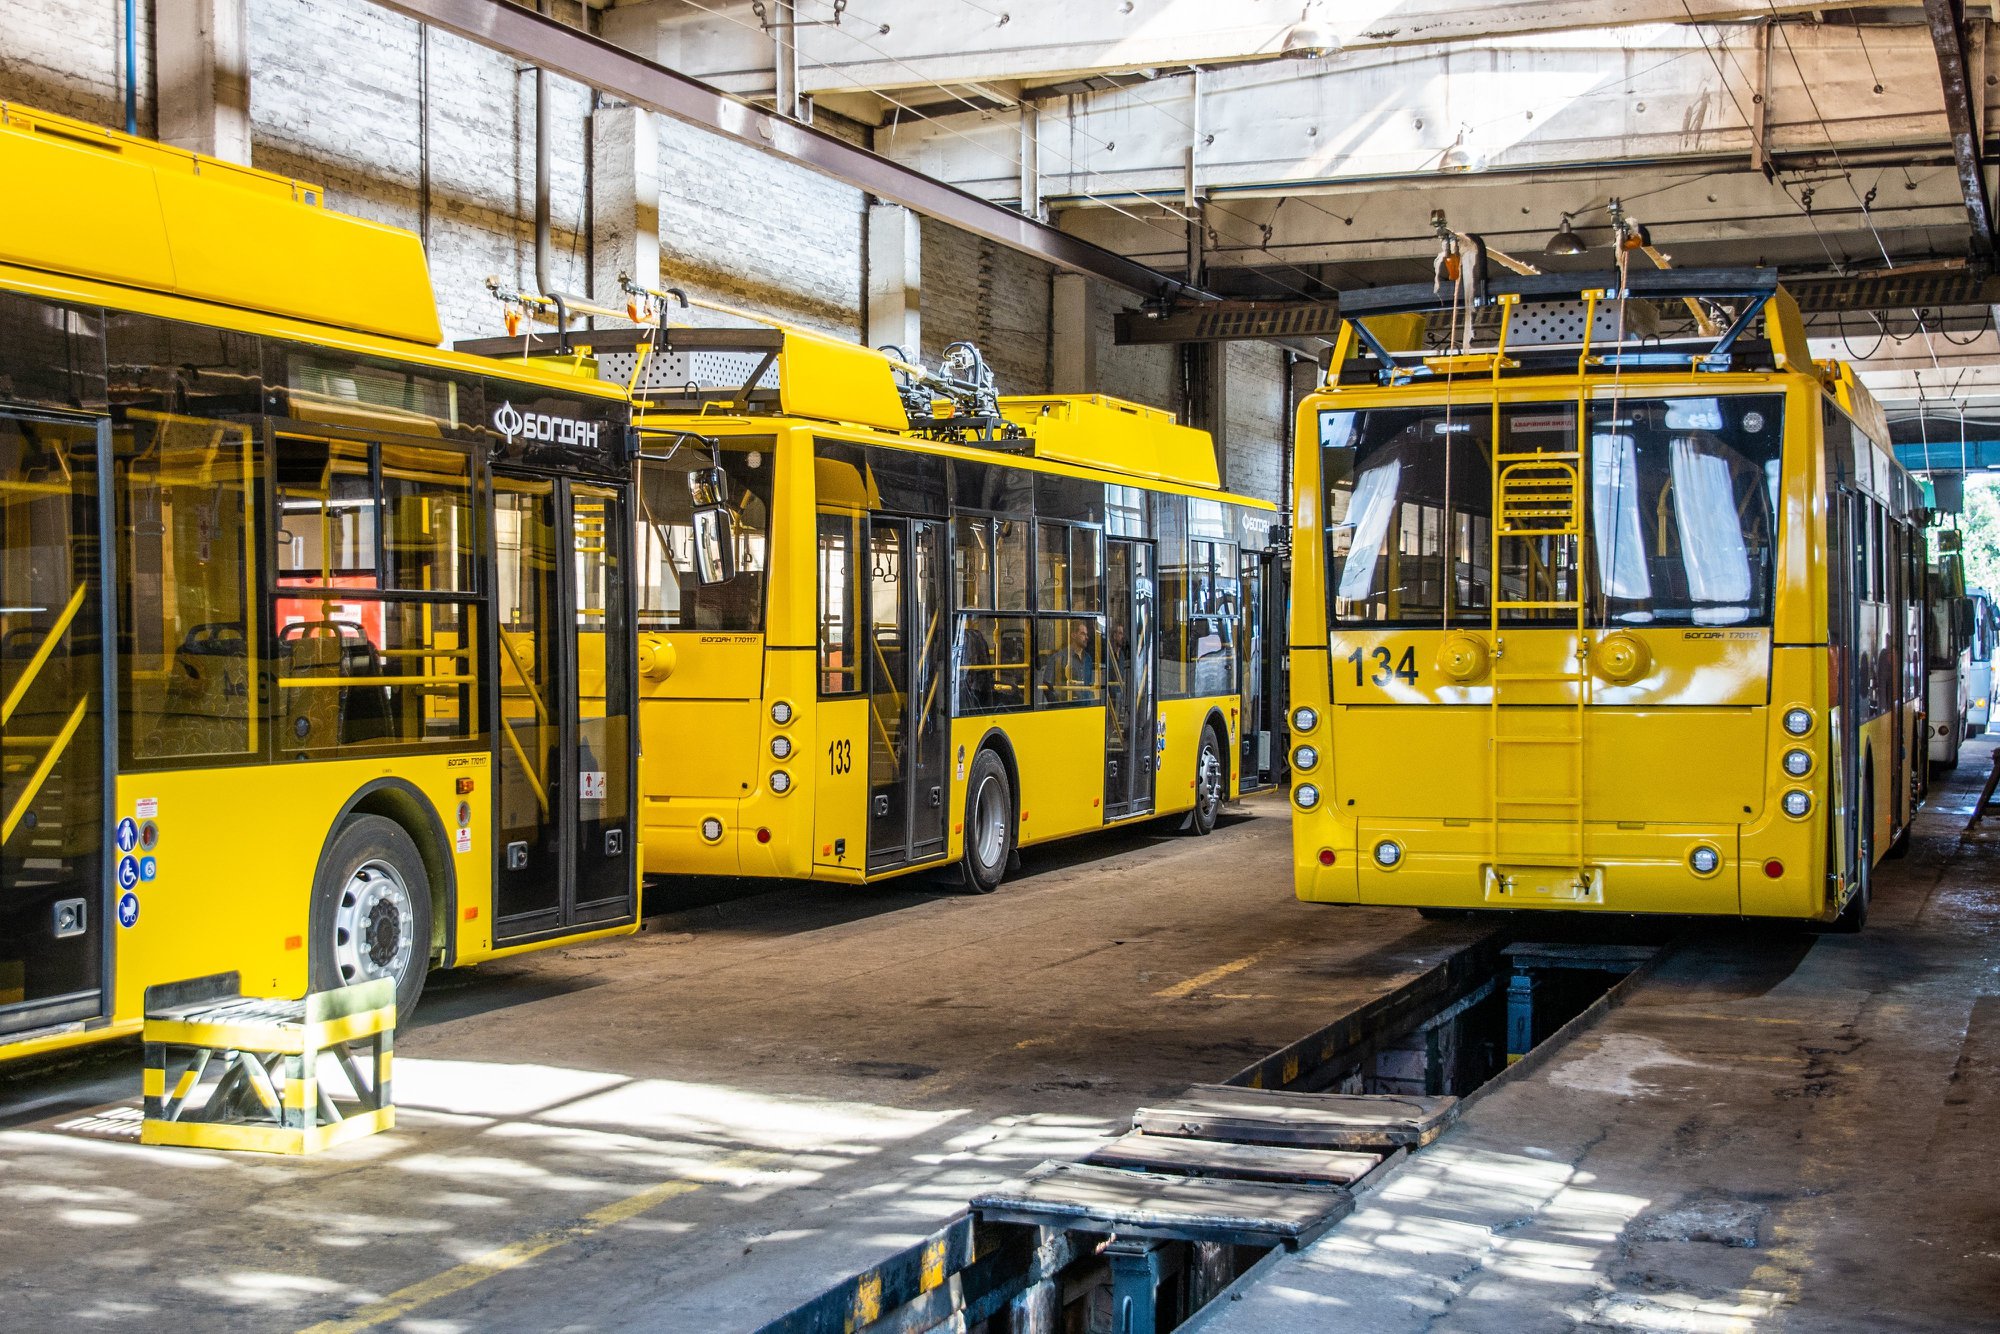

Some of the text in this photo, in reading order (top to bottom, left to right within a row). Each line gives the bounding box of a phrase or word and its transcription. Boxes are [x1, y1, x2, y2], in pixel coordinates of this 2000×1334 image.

[522, 412, 599, 448] БОГДАН
[1347, 645, 1419, 687] 134
[828, 738, 851, 776] 133
